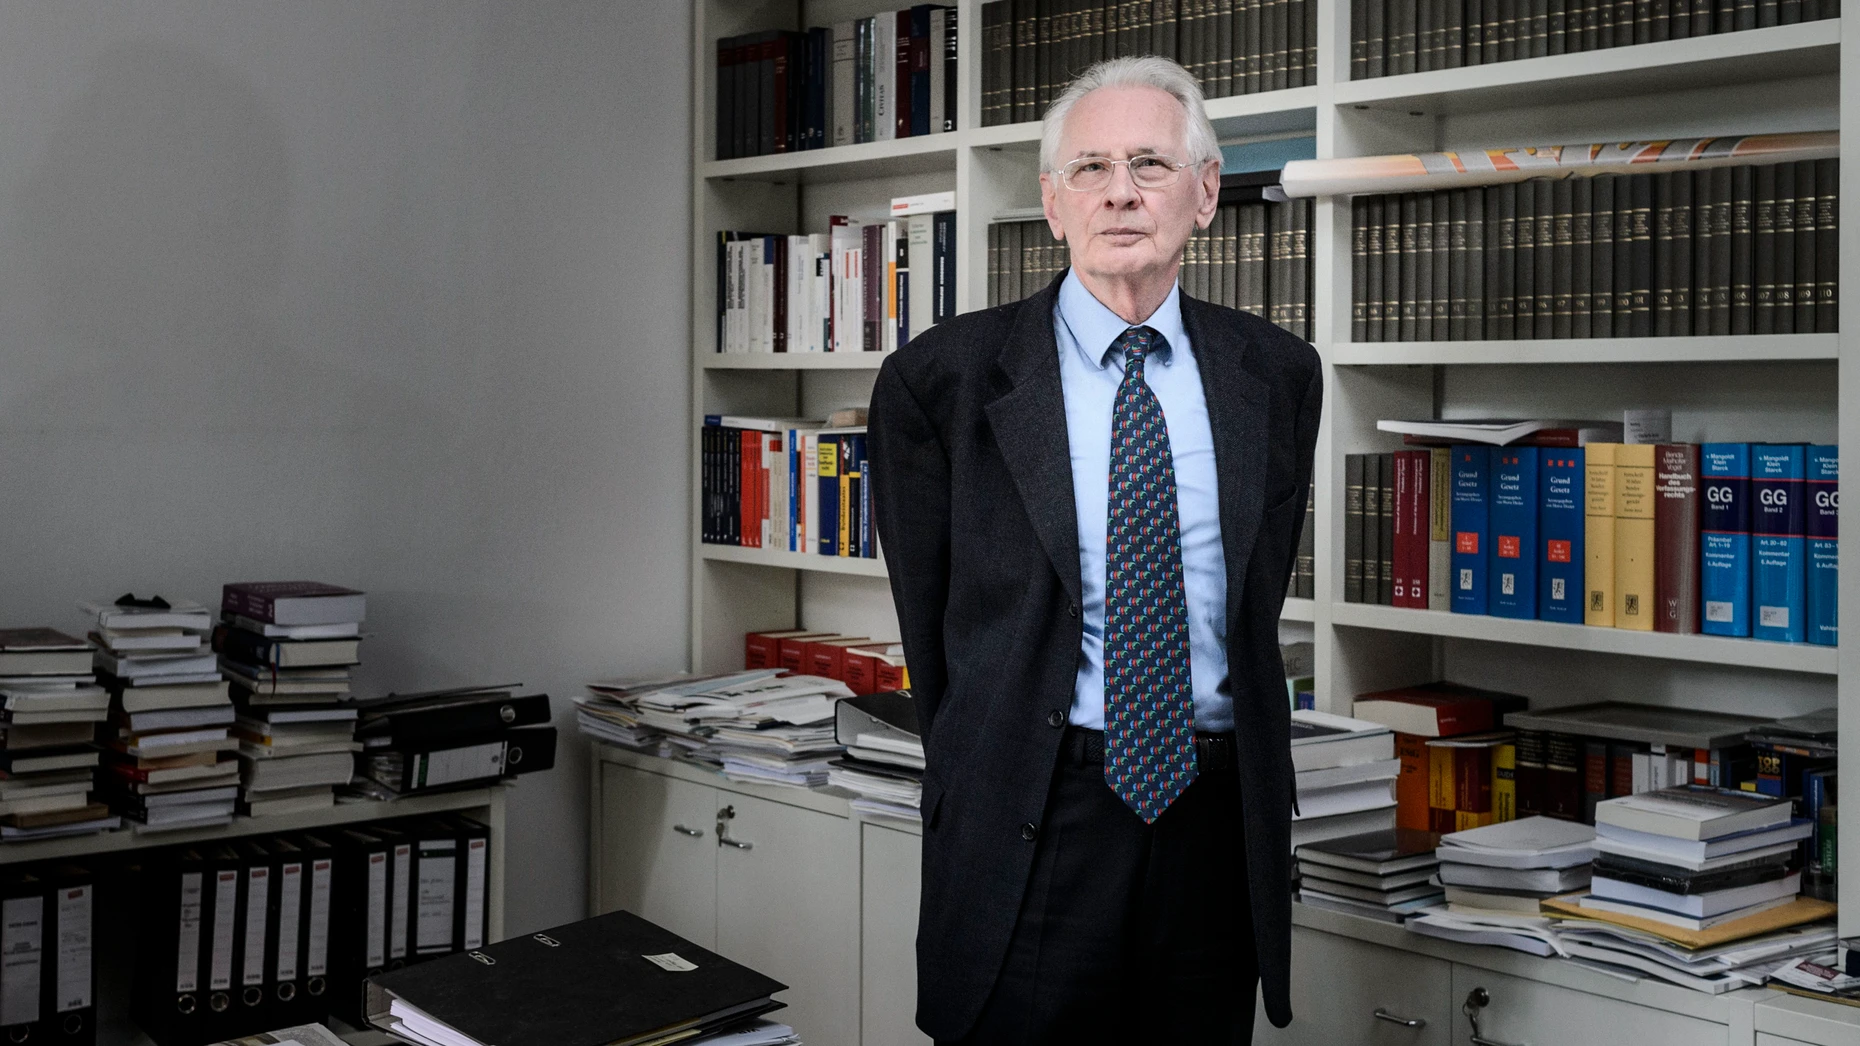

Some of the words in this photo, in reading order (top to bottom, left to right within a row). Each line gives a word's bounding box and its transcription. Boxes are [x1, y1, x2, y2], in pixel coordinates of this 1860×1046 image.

[1710, 453, 1735, 461] Mangoldt
[1500, 474, 1520, 482] Grund
[1550, 476, 1571, 485] Grund
[1658, 472, 1692, 480] Handbuch
[1500, 483, 1519, 491] Gesetz
[1550, 485, 1570, 494] Gesetz
[1656, 484, 1696, 493] Verfassungs-
[1663, 491, 1685, 499] rechts
[1707, 486, 1733, 502] GG
[1760, 489, 1787, 505] GG
[1669, 610, 1676, 618] G
[1757, 755, 1781, 766] TOP
[1759, 765, 1781, 775] 500
